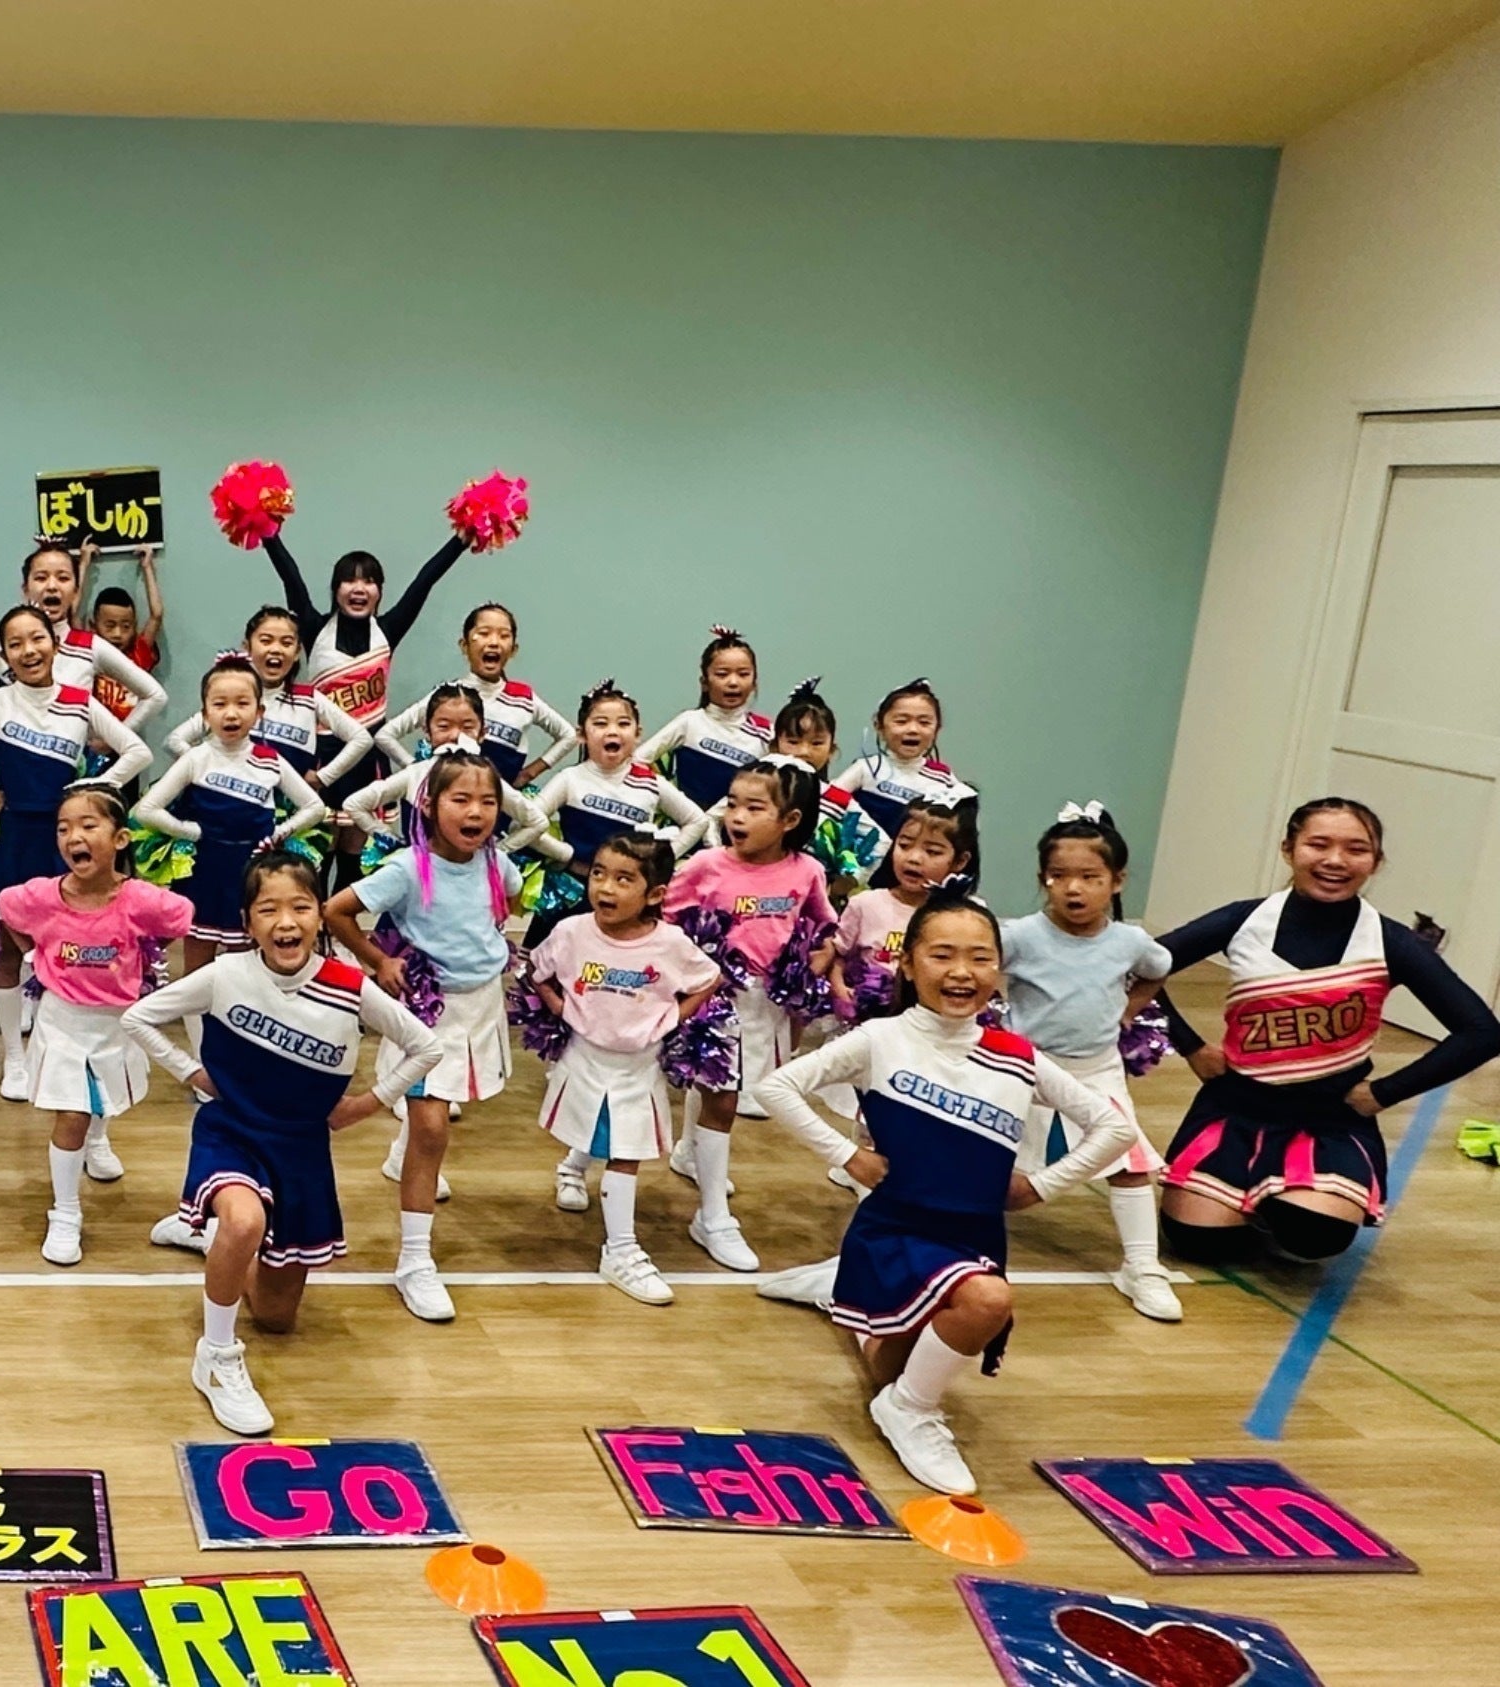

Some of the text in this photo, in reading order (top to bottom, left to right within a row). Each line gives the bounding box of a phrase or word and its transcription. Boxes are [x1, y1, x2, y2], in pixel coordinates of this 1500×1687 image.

[735, 896, 797, 914] NS GROUP
[61, 942, 118, 963] NS GROUP
[582, 962, 649, 988] NS GROUP
[228, 1005, 345, 1067] GLITTERS
[1240, 994, 1365, 1054] ZERO
[891, 1071, 1024, 1143] GLITTERS
[218, 1444, 429, 1539] Go
[603, 1433, 880, 1526] Fight
[1062, 1474, 1389, 1558] Win
[62, 1578, 348, 1687] ARE
